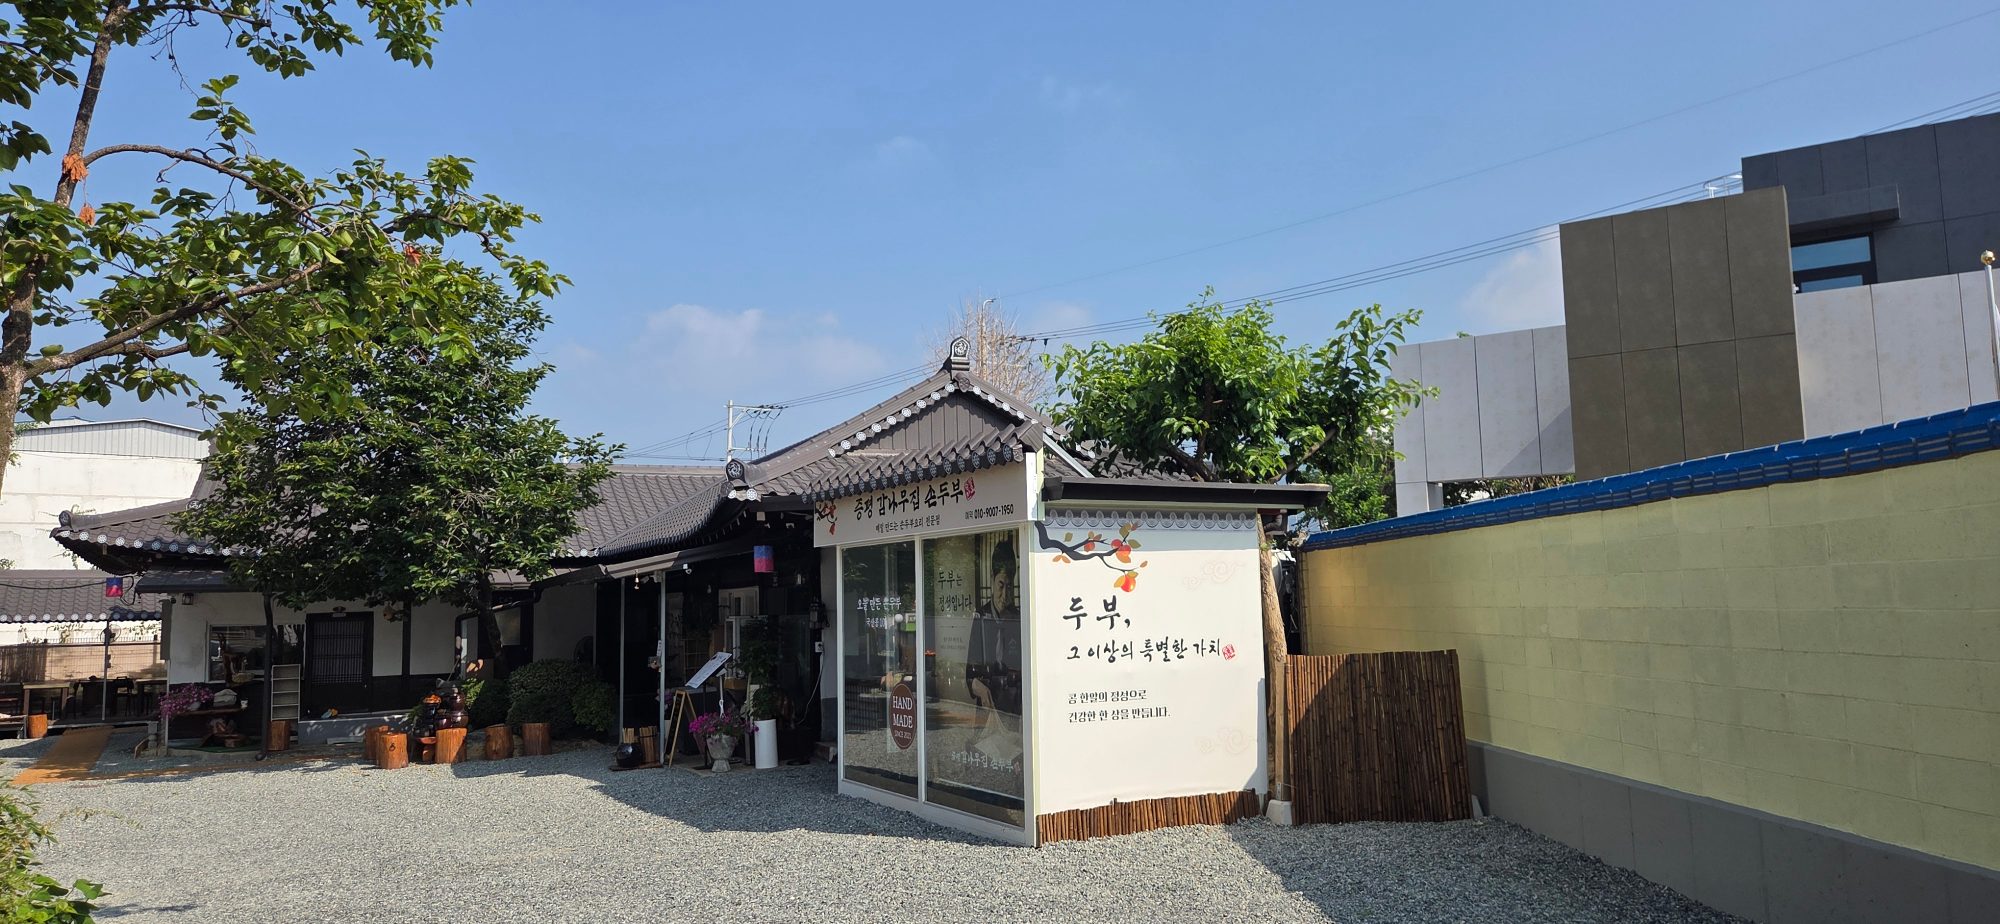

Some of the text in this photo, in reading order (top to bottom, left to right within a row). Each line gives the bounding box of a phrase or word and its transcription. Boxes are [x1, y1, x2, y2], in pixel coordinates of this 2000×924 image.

[854, 495, 873, 520] 증평
[877, 486, 920, 516] 감나무집
[924, 478, 963, 508] 손두부
[938, 570, 962, 589] 두부는
[1067, 645, 1080, 660] 그
[1087, 639, 1133, 663] 이상의
[1139, 636, 1187, 662] 특별한
[1192, 638, 1221, 657] 가치
[893, 696, 913, 710] HAND
[1067, 693, 1077, 704] 콩
[1110, 689, 1147, 702] 정성으로
[893, 714, 913, 728] MADE
[1068, 706, 1171, 723] 건강한 한 상을 만듭니다.
